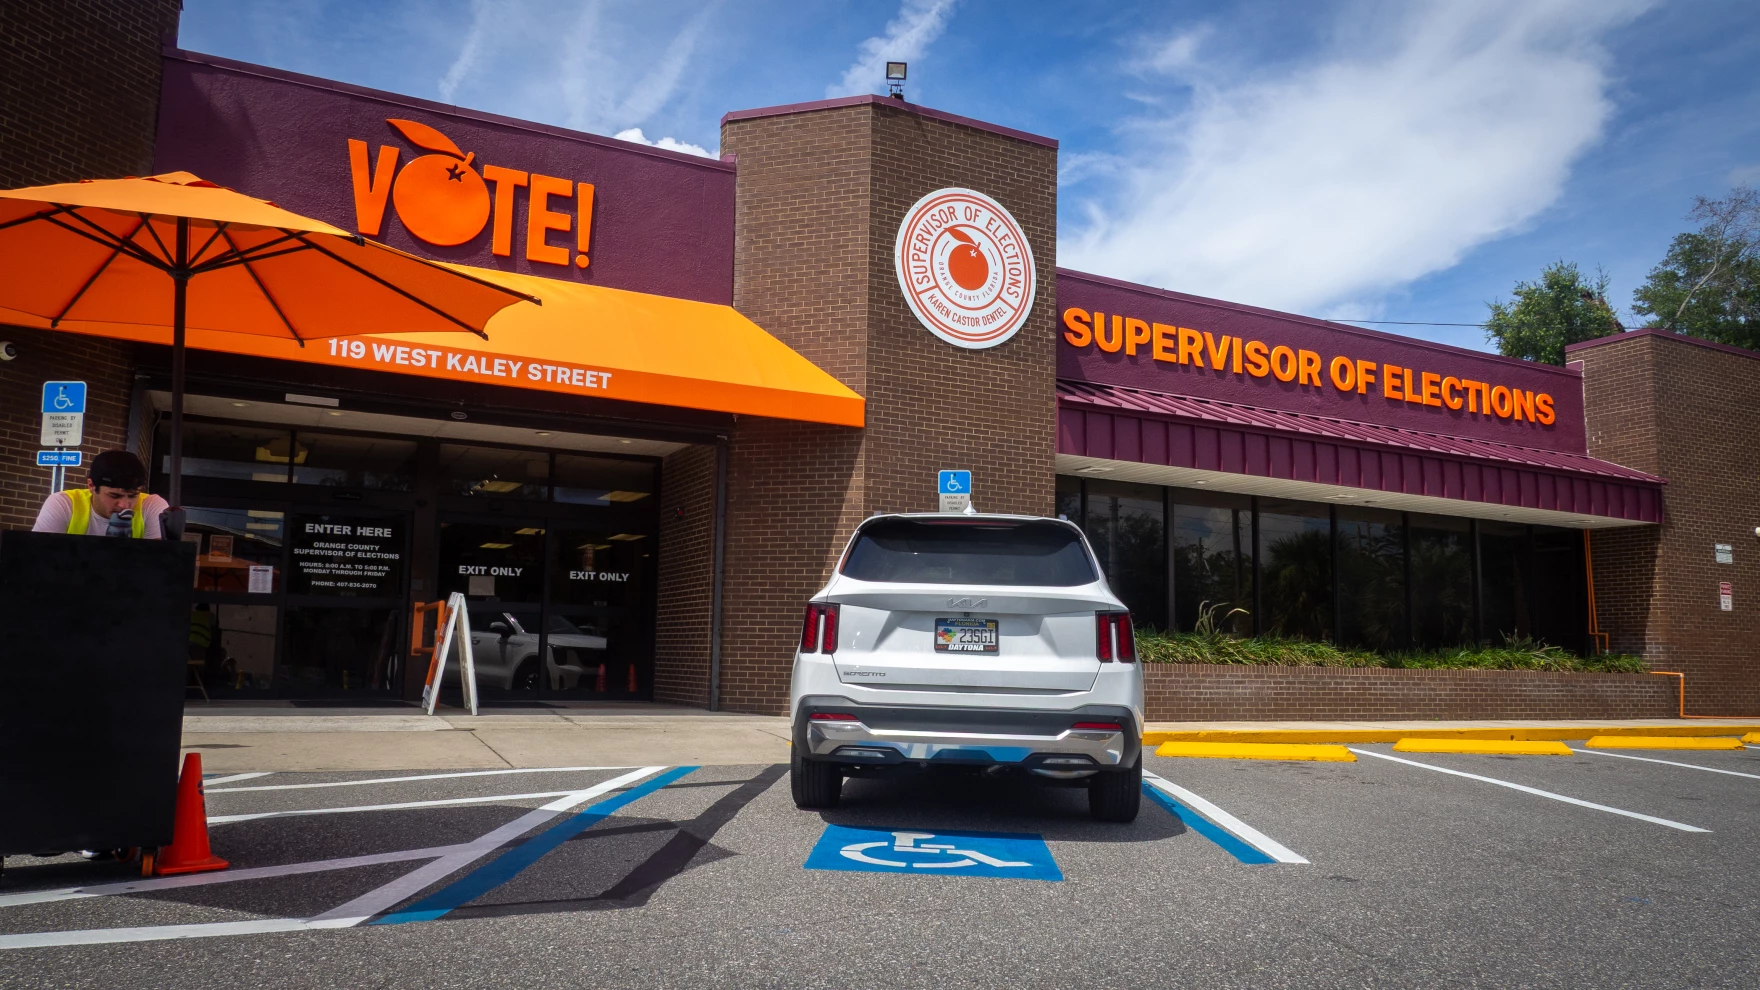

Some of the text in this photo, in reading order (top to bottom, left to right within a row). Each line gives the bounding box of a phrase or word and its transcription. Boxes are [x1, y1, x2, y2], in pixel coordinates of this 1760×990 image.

[348, 121, 594, 268] VOTE!
[912, 205, 1022, 299] SUPERVISOR OF ELECTIONS
[938, 261, 954, 290] ORANGE
[954, 290, 980, 301] COUNTY
[927, 294, 1007, 327] KAREN CASTOR DENTEL
[328, 338, 612, 390] 119 WEST KALEY STREET
[1063, 307, 1556, 425] SUPERVISOR OF ELECTIONS
[305, 523, 392, 538] ENTER HERE
[313, 541, 380, 551] ORANGE COUNTY
[294, 548, 343, 557] SUPERVISOR
[357, 552, 400, 560] ELECTIONS
[458, 565, 523, 577] EXIT ONLY
[569, 570, 630, 582] EXIT ONLY
